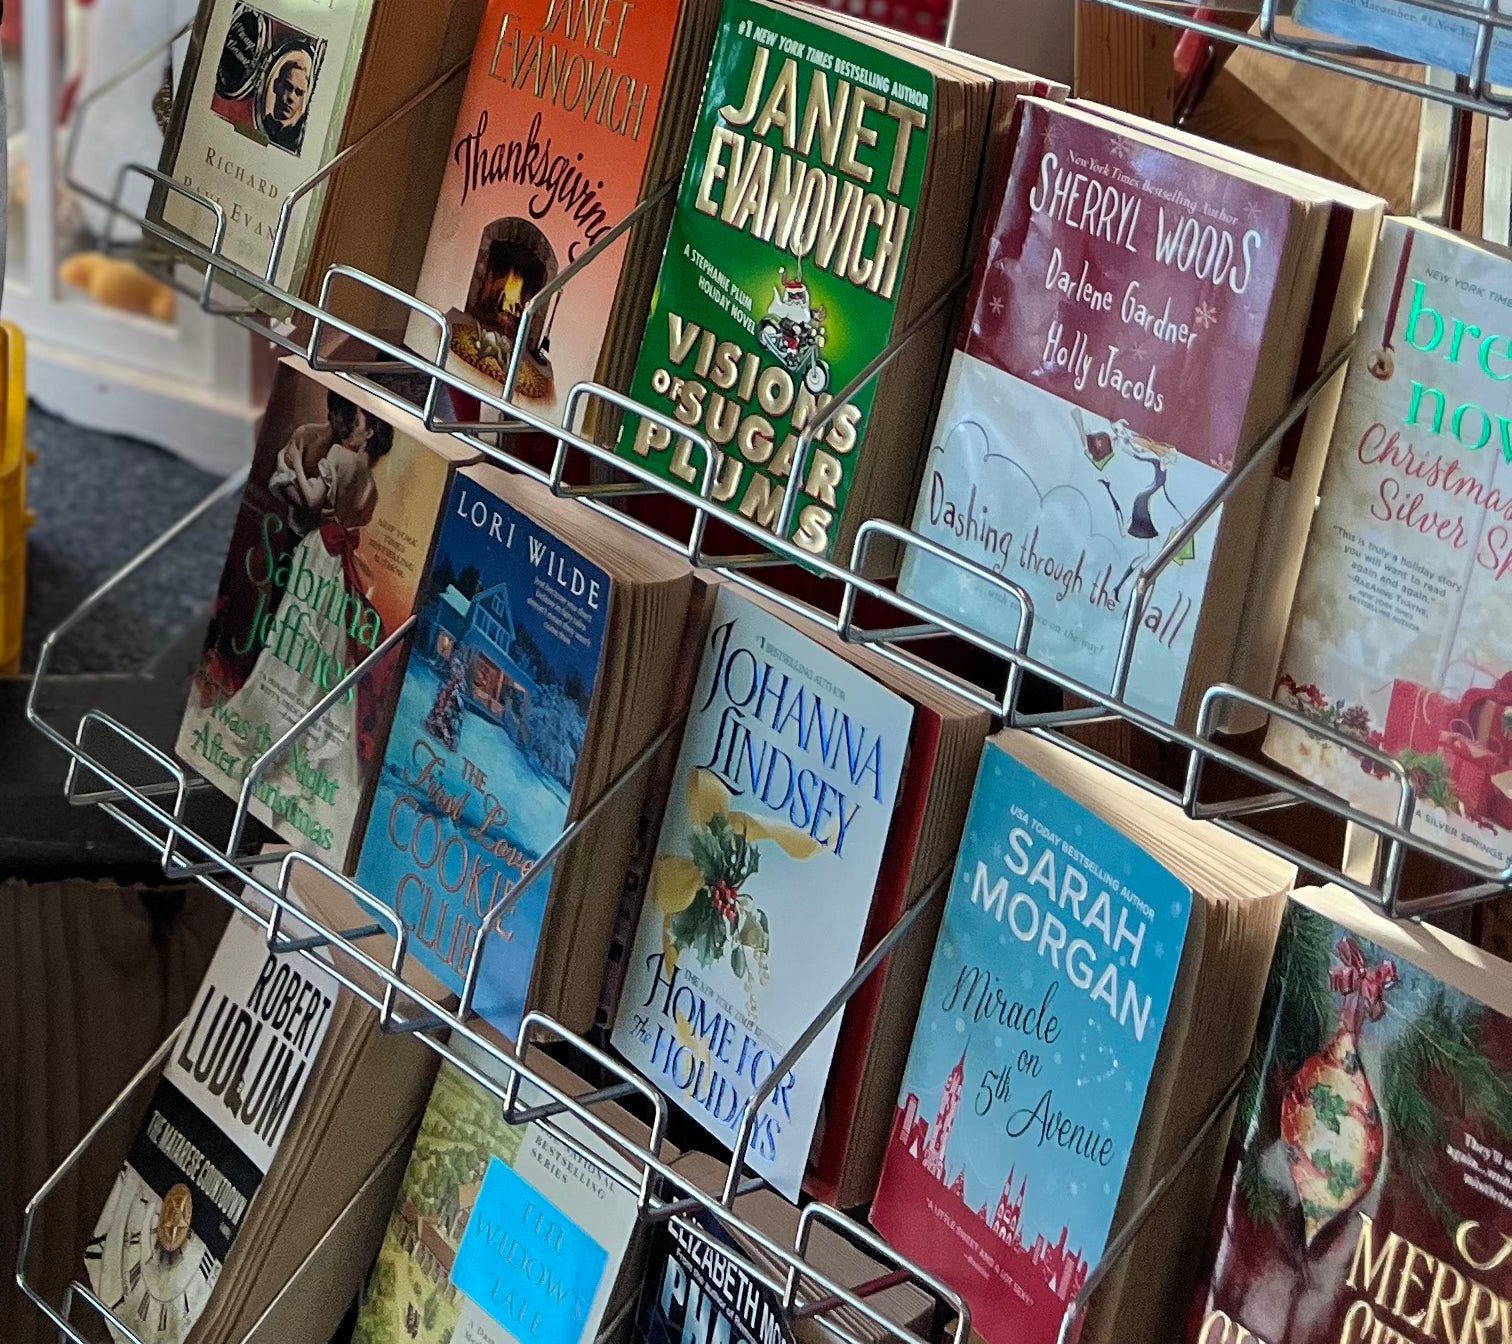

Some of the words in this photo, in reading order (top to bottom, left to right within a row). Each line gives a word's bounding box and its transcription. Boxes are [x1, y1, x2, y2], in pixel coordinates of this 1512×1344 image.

[489, 13, 649, 142] EVANOVICH
[738, 20, 753, 38] #1
[753, 26, 778, 47] NEW
[778, 35, 804, 58] YORK
[806, 46, 834, 70] TIMES
[834, 58, 890, 93] BESTSELLING
[891, 79, 930, 110] AUTHOR
[719, 45, 927, 196] JANET
[205, 146, 278, 199] RICHARD
[695, 125, 911, 299] EVANOVICH
[1029, 151, 1141, 253] SHERRYL
[1155, 206, 1262, 295] WOODS
[1065, 149, 1090, 168] New
[1089, 158, 1110, 176] York
[1111, 165, 1139, 189] Times
[1142, 178, 1198, 214] Bestselling
[1201, 201, 1239, 225] Author
[691, 249, 730, 292] STEPHANIE
[730, 284, 752, 311] PLUM
[698, 275, 730, 312] HOLIDAY
[731, 304, 755, 335] NOVEL
[1045, 247, 1113, 311] Darlene
[1122, 280, 1197, 349] Gardner
[1425, 268, 1451, 286] NEW
[1455, 279, 1486, 297] YORK
[651, 368, 684, 401] OF
[668, 311, 863, 454] VISIONS
[1043, 320, 1092, 391] Holly
[1097, 345, 1164, 413] Jacobs
[633, 416, 833, 554] PLUMS
[673, 380, 843, 509] SUGAR
[458, 490, 516, 549] LORI
[529, 535, 600, 609] WILDE
[929, 470, 1013, 574] Dashing
[1020, 525, 1086, 602] through
[1089, 563, 1117, 612] the
[1370, 477, 1468, 550] Silver
[245, 513, 381, 651] Sabrina
[1345, 545, 1361, 558] you
[1365, 555, 1382, 568] will
[1384, 564, 1407, 580] want
[1411, 575, 1421, 585] to
[1424, 582, 1446, 597] read
[1351, 562, 1377, 578] again
[1380, 576, 1398, 589] and
[1368, 542, 1389, 559] truly
[1400, 556, 1434, 580] holiday
[1438, 575, 1462, 592] story
[700, 617, 884, 805] JOHANNA
[461, 756, 488, 794] THE
[695, 706, 861, 860] LINDSEY
[1010, 804, 1029, 825] USA
[1031, 819, 1062, 846] TODAY
[1062, 842, 1120, 892] BESTSELLING
[1120, 886, 1155, 923] AUTHOR
[1425, 815, 1457, 837] SILVER
[1460, 832, 1503, 861] SPRINGS
[1004, 827, 1146, 968] SARAH
[971, 861, 1152, 1042] MORGAN
[248, 952, 333, 1058] ROBERT
[643, 952, 737, 1065] HOME
[942, 965, 1061, 1044] Miracle
[178, 984, 306, 1148] LUDLUM
[1017, 1048, 1043, 1079] on
[530, 1148, 568, 1184] SERIES
[976, 1064, 1013, 1117] 5th
[1006, 1089, 1114, 1167] Avenue
[535, 1135, 605, 1200] BESTSELLING
[522, 1201, 565, 1253] THE
[668, 1219, 760, 1329] ELIZABETH
